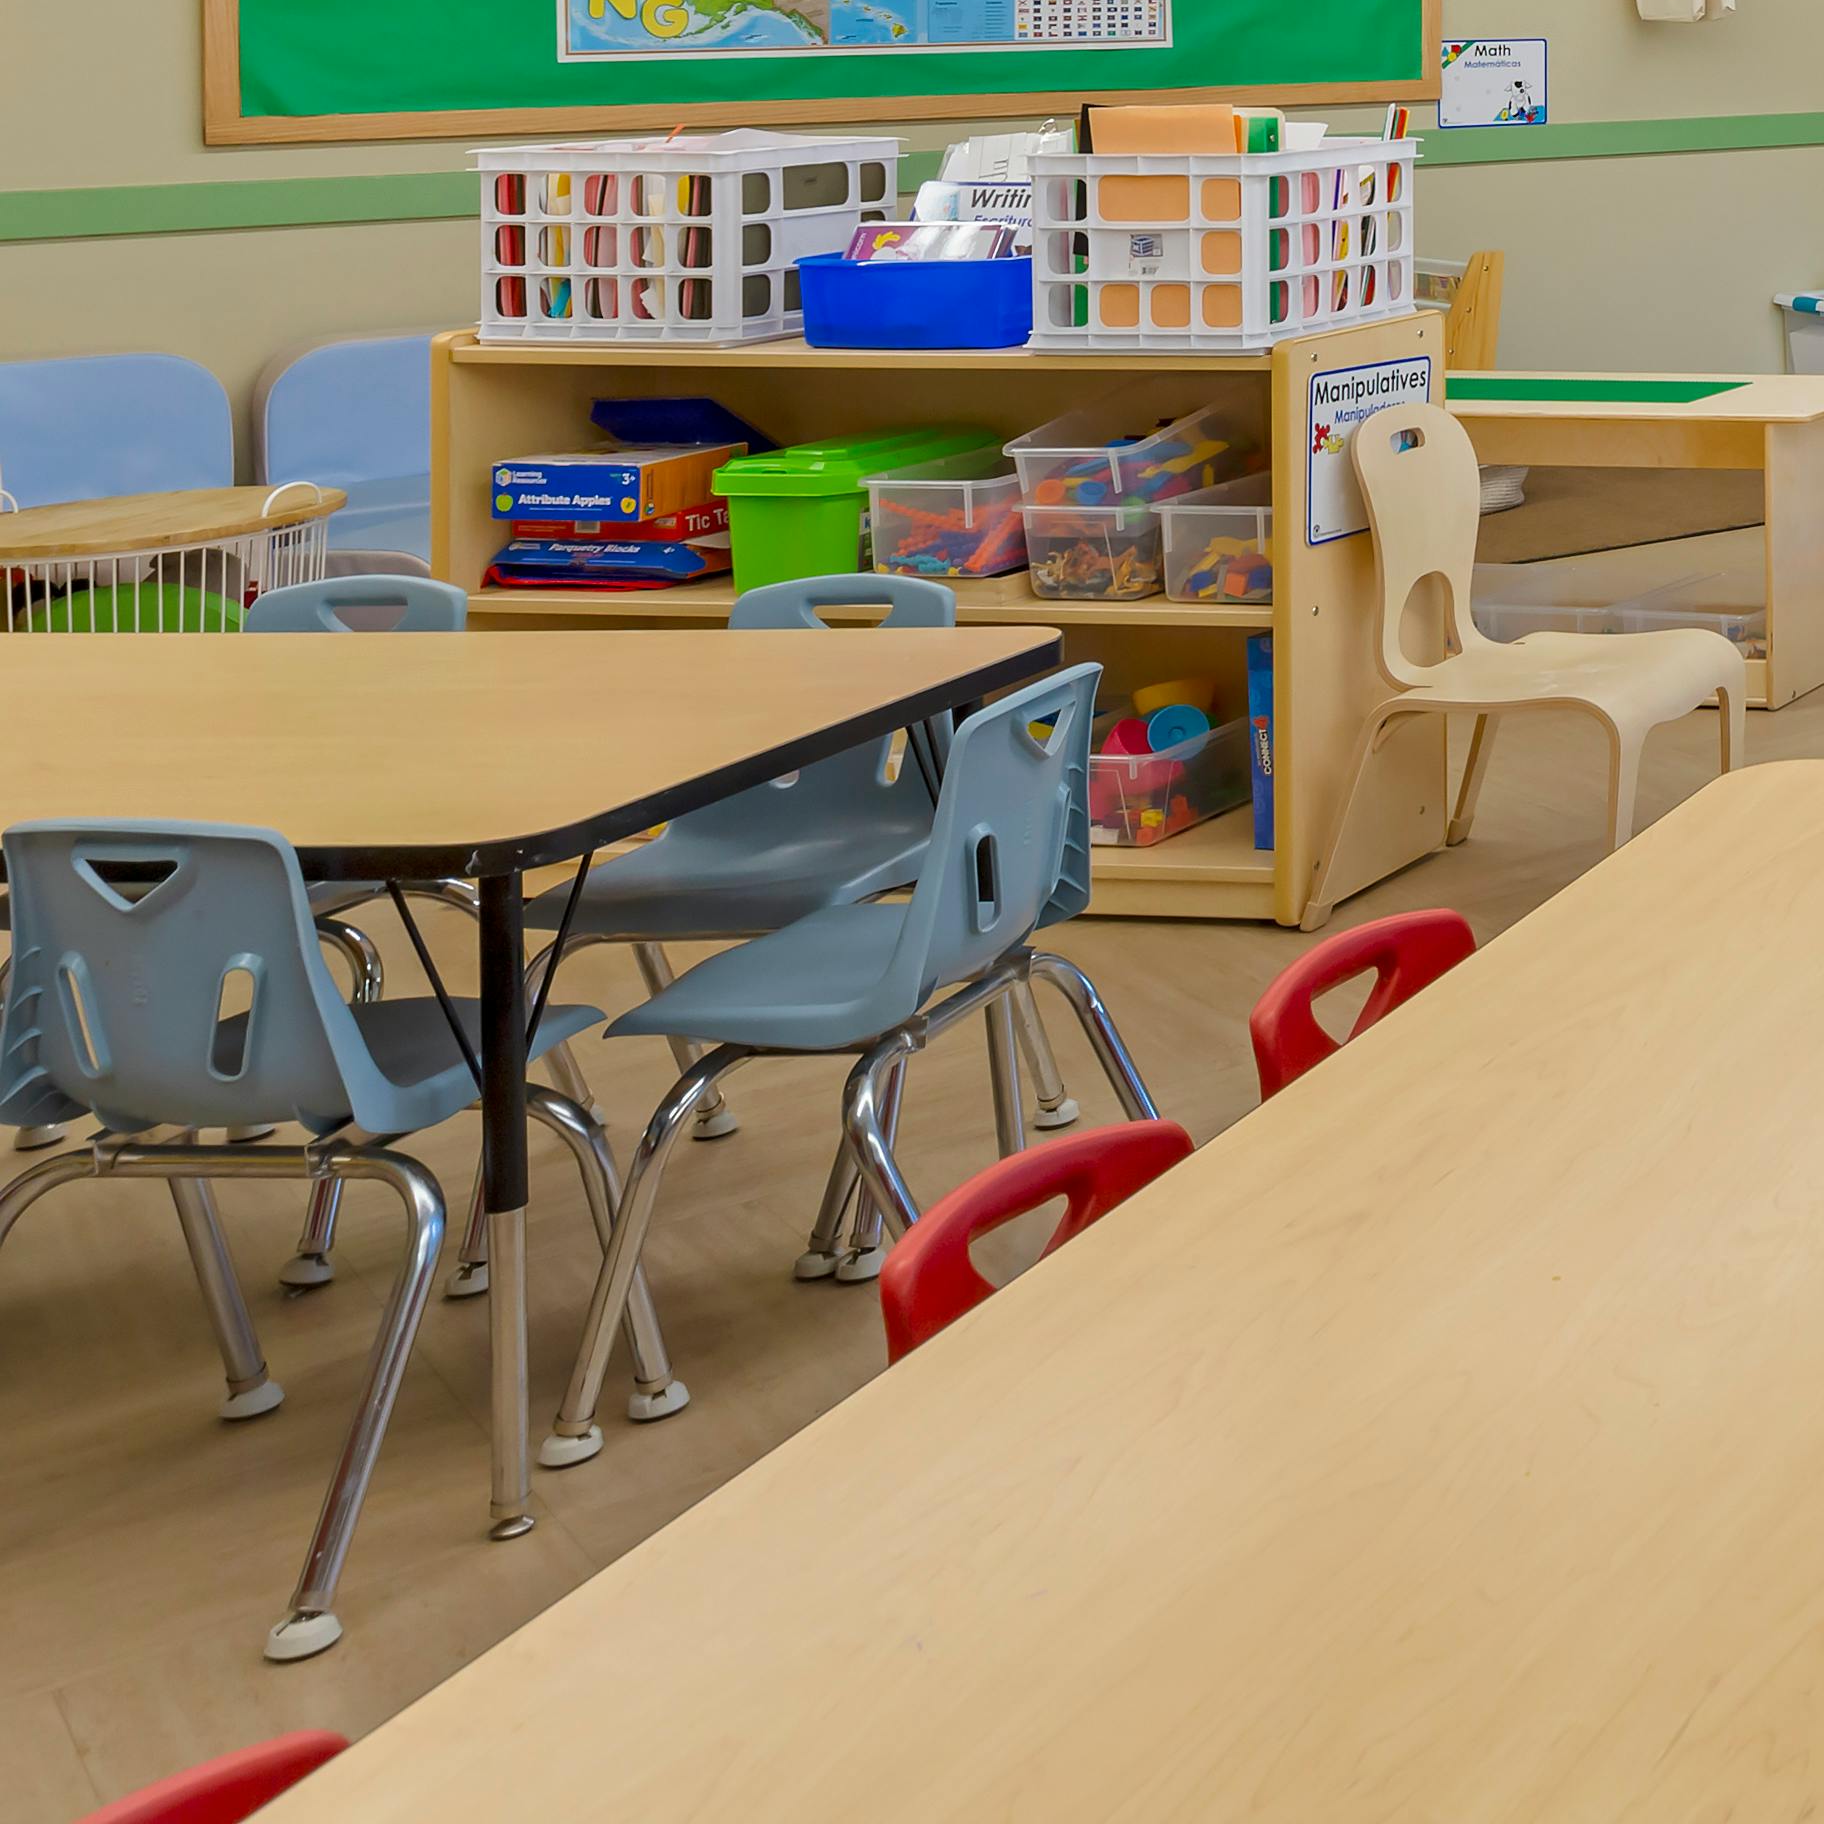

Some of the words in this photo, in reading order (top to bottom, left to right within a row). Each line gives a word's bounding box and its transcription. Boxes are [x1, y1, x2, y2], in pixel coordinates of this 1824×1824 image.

[1474, 43, 1511, 58] Math
[1464, 58, 1522, 69] Matemáticas
[1314, 369, 1426, 406] Manipulatives
[512, 477, 548, 485] Resources
[622, 472, 636, 485] 3+
[518, 494, 571, 506] Attribute
[571, 494, 611, 507] Apples
[685, 513, 711, 532] Tic
[549, 542, 603, 554] Parquetry
[603, 543, 641, 554] Blocks
[1253, 715, 1269, 730] 4
[1258, 729, 1273, 775] CONNECT
